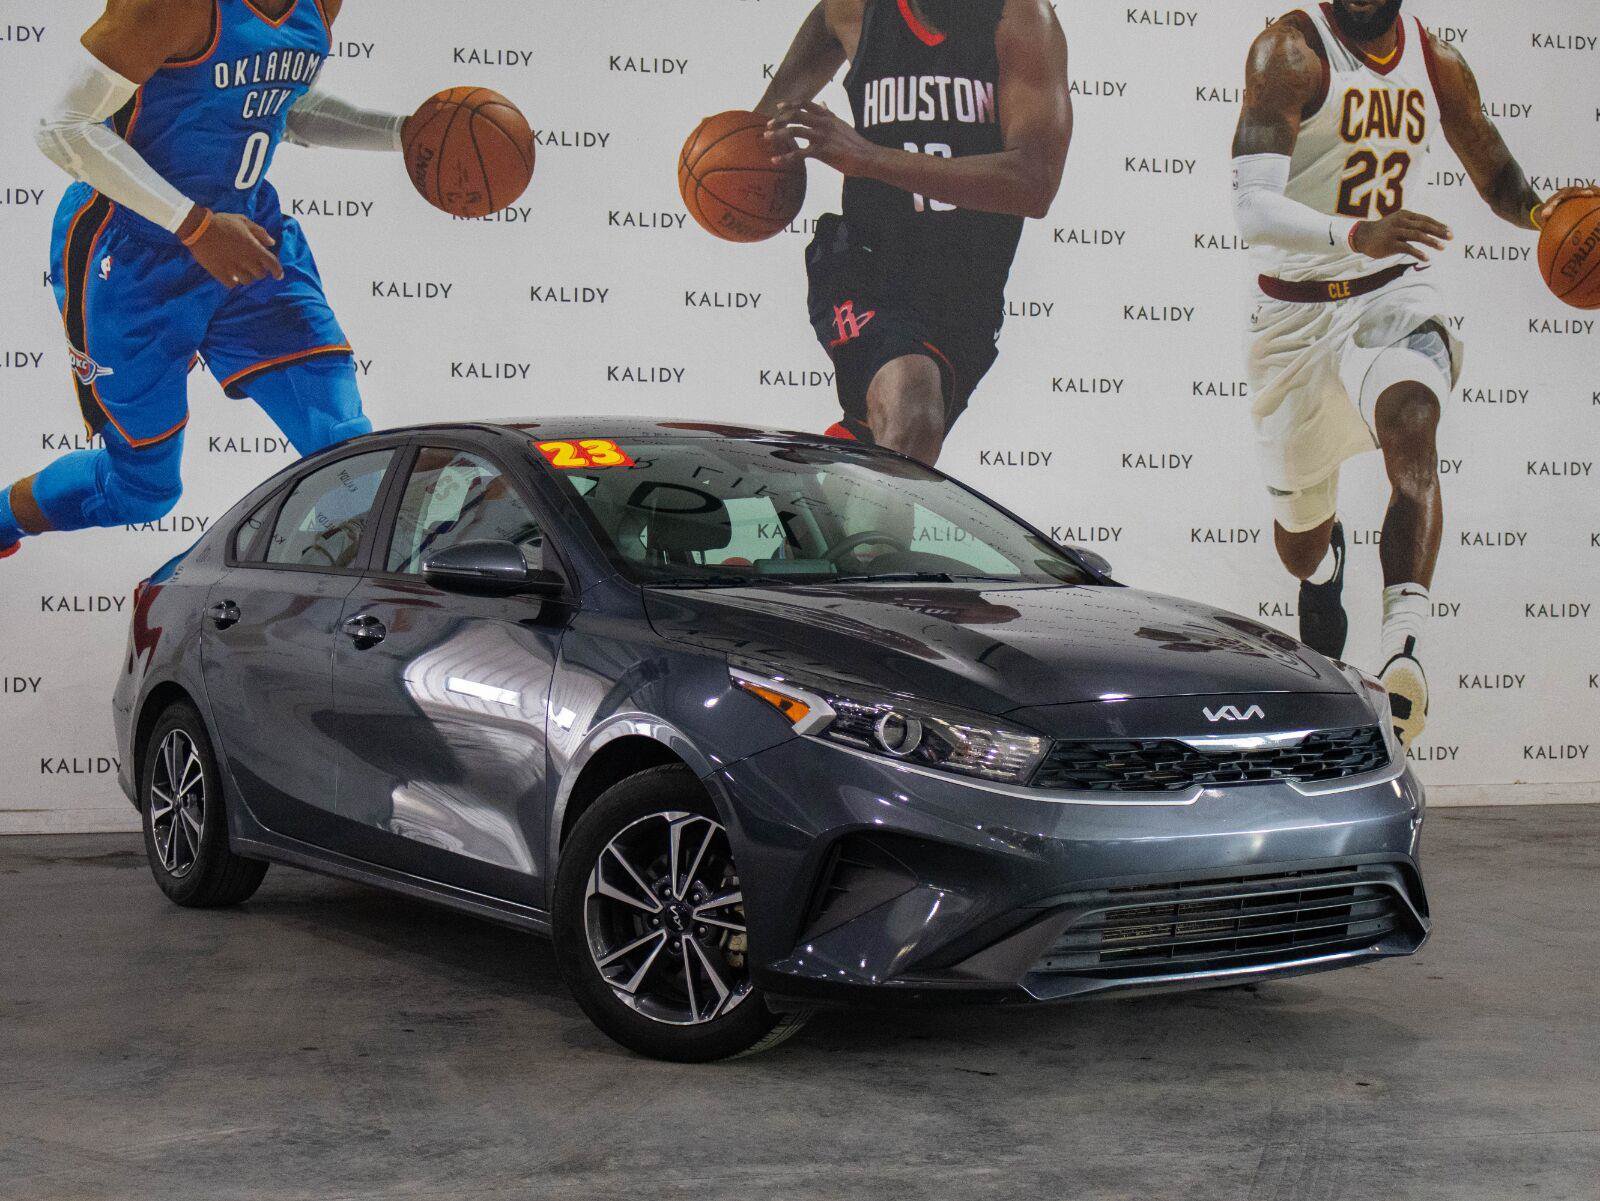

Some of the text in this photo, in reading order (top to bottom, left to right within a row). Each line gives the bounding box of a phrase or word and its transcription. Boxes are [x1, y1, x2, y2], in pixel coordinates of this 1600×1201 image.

[1127, 9, 1198, 26] KALIDY
[0, 25, 45, 42] IDY
[1426, 27, 1468, 43] IDY
[1532, 33, 1597, 51] KALIDY
[328, 42, 375, 58] IDY
[453, 47, 533, 66] KALIDY
[609, 55, 689, 74] KALIDY
[863, 75, 996, 128] HOUSTON
[1196, 86, 1246, 103] KALI
[242, 88, 292, 119] CITY
[1340, 87, 1426, 144] CAVS
[532, 130, 610, 148] KALIDY
[234, 131, 270, 190] 0
[1125, 157, 1196, 175] KALIDY
[1335, 148, 1411, 219] 23
[292, 199, 374, 217] KALIDY
[608, 211, 687, 229] KALIDY
[1053, 228, 1125, 245] KALIDY
[1464, 245, 1531, 261] KALIDY
[372, 281, 453, 299] KALIDY
[530, 286, 609, 304] KALIDY
[1328, 280, 1351, 299] CLE
[684, 291, 762, 308] KALIDY
[1123, 305, 1195, 321] KALIDY
[1529, 318, 1594, 334] KALIDY
[451, 361, 531, 379] KALIDY
[607, 365, 685, 383] KALIDY
[759, 369, 836, 387] KALIDY
[1052, 377, 1124, 394] KALIDY
[1462, 388, 1529, 403] KALIDY
[209, 436, 290, 453] KALIDY
[540, 440, 625, 466] 23
[979, 451, 1052, 467] KALIDY
[1122, 453, 1193, 470] KALIDY
[1527, 461, 1592, 476] KALIDY
[1051, 526, 1123, 542] KALIDY
[1191, 529, 1261, 544] KALIDY
[1461, 532, 1527, 546] KALIDY
[41, 596, 126, 612] KALIDY
[1525, 604, 1591, 618] KALIDY
[1459, 674, 1526, 689] KALIDY
[1523, 745, 1589, 760] KALIDY
[41, 757, 122, 774] KALIDY
